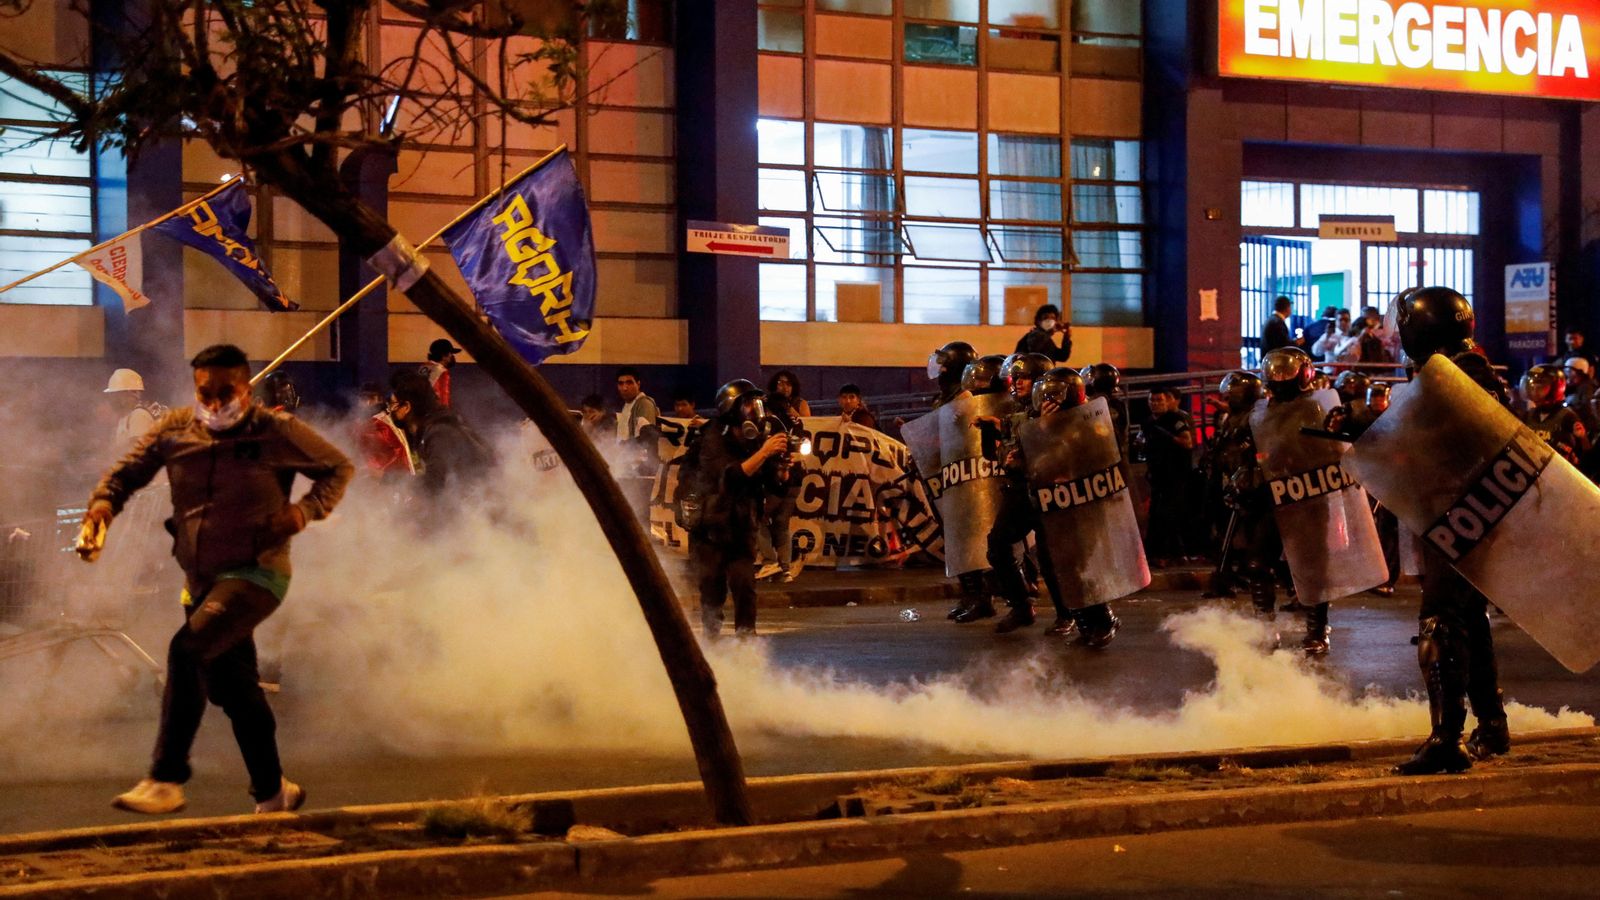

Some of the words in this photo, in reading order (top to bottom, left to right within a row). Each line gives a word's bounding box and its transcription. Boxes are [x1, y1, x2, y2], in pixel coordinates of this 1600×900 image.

[1244, 0, 1589, 78] EMERGENCIA
[694, 231, 722, 240] TRIAJE
[728, 234, 786, 243] RESPIRATORIO
[1511, 267, 1545, 288] ATU
